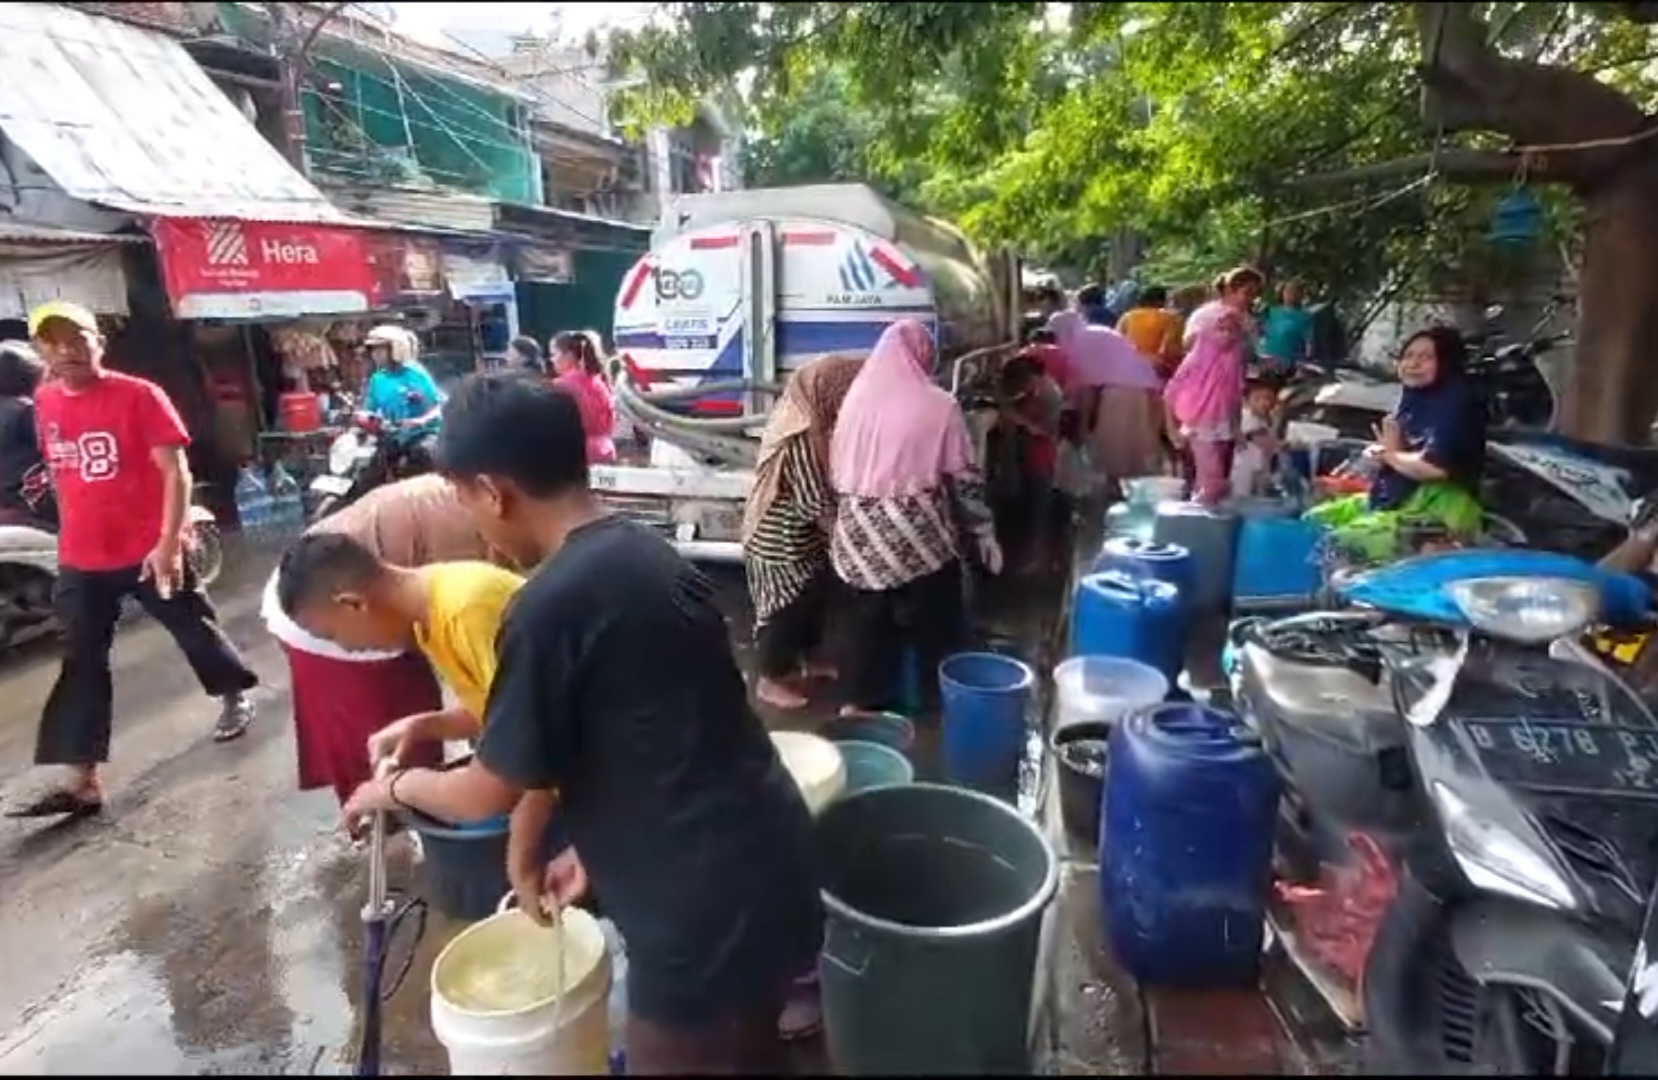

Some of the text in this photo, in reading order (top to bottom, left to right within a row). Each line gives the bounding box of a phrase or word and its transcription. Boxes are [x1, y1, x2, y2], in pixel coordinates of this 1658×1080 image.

[260, 238, 320, 265] Hera
[826, 294, 852, 304] PAM
[78, 431, 119, 482] 8
